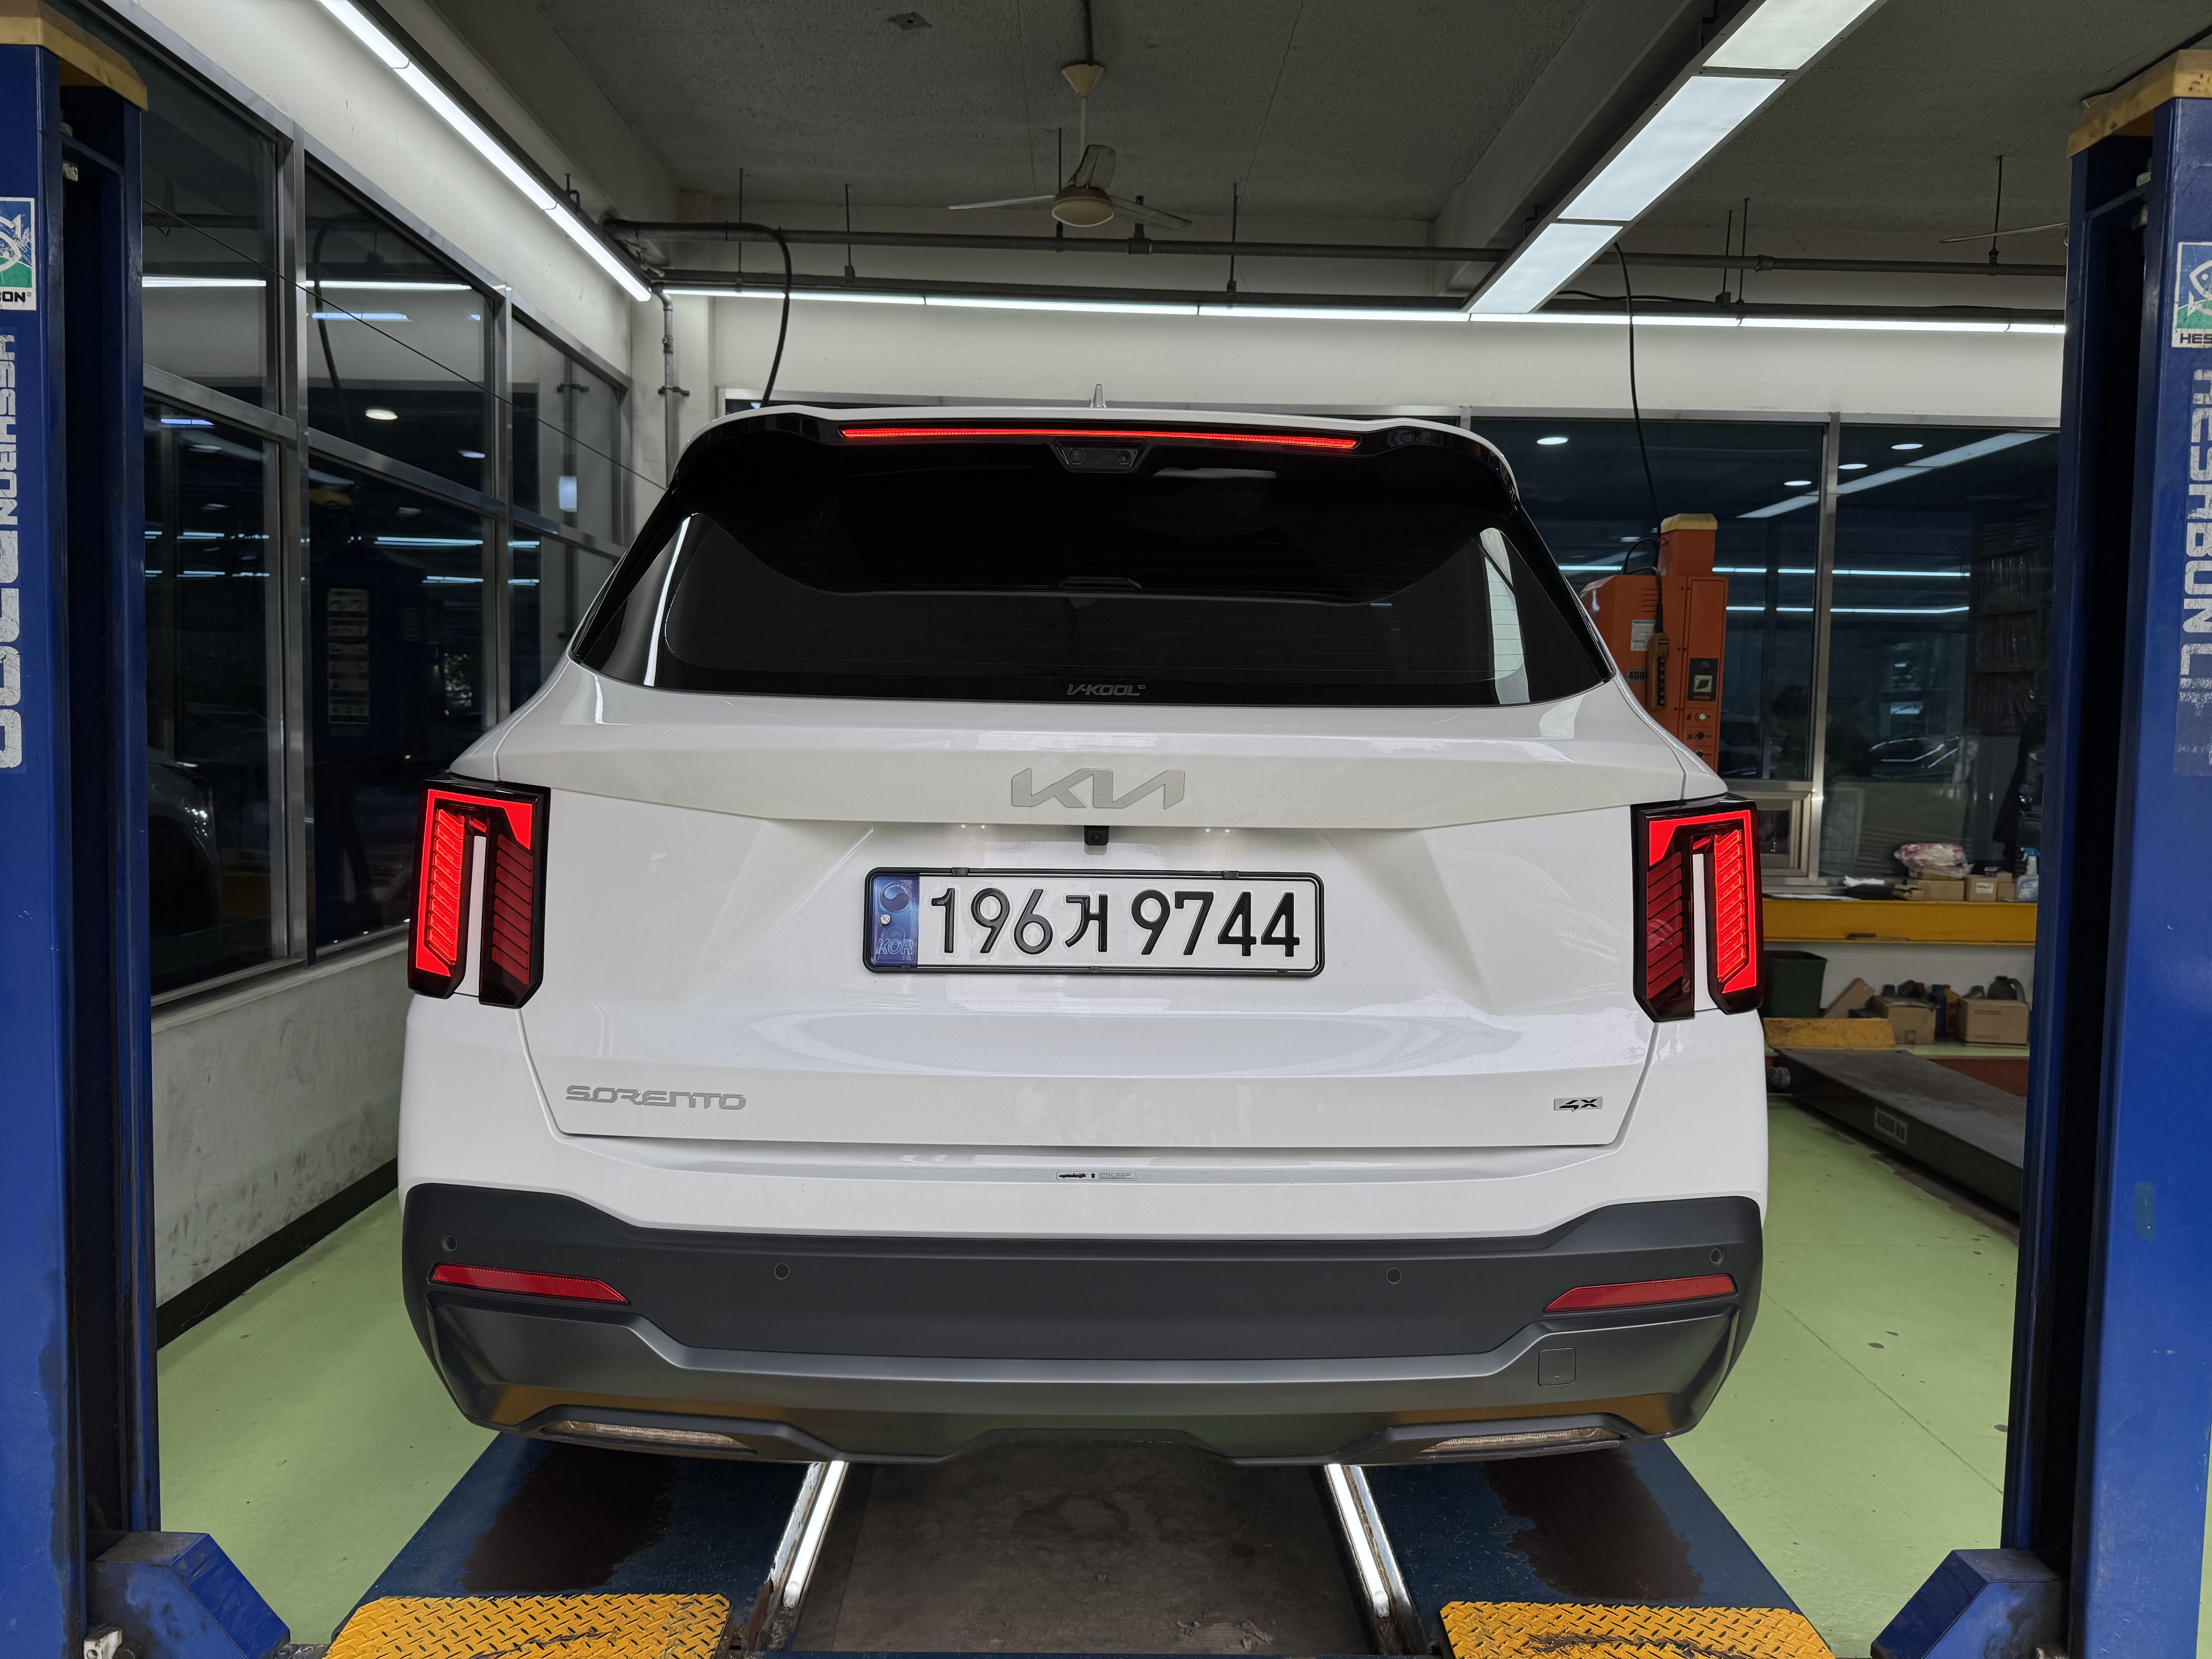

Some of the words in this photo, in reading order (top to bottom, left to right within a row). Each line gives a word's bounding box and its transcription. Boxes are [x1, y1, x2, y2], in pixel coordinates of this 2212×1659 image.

[1067, 684, 1140, 696] V-KOOL
[1012, 768, 1185, 809] KIA
[931, 888, 1108, 955] 196거
[1131, 889, 1300, 957] 9744
[876, 938, 914, 954] KOR
[566, 1085, 746, 1110] SORENTO
